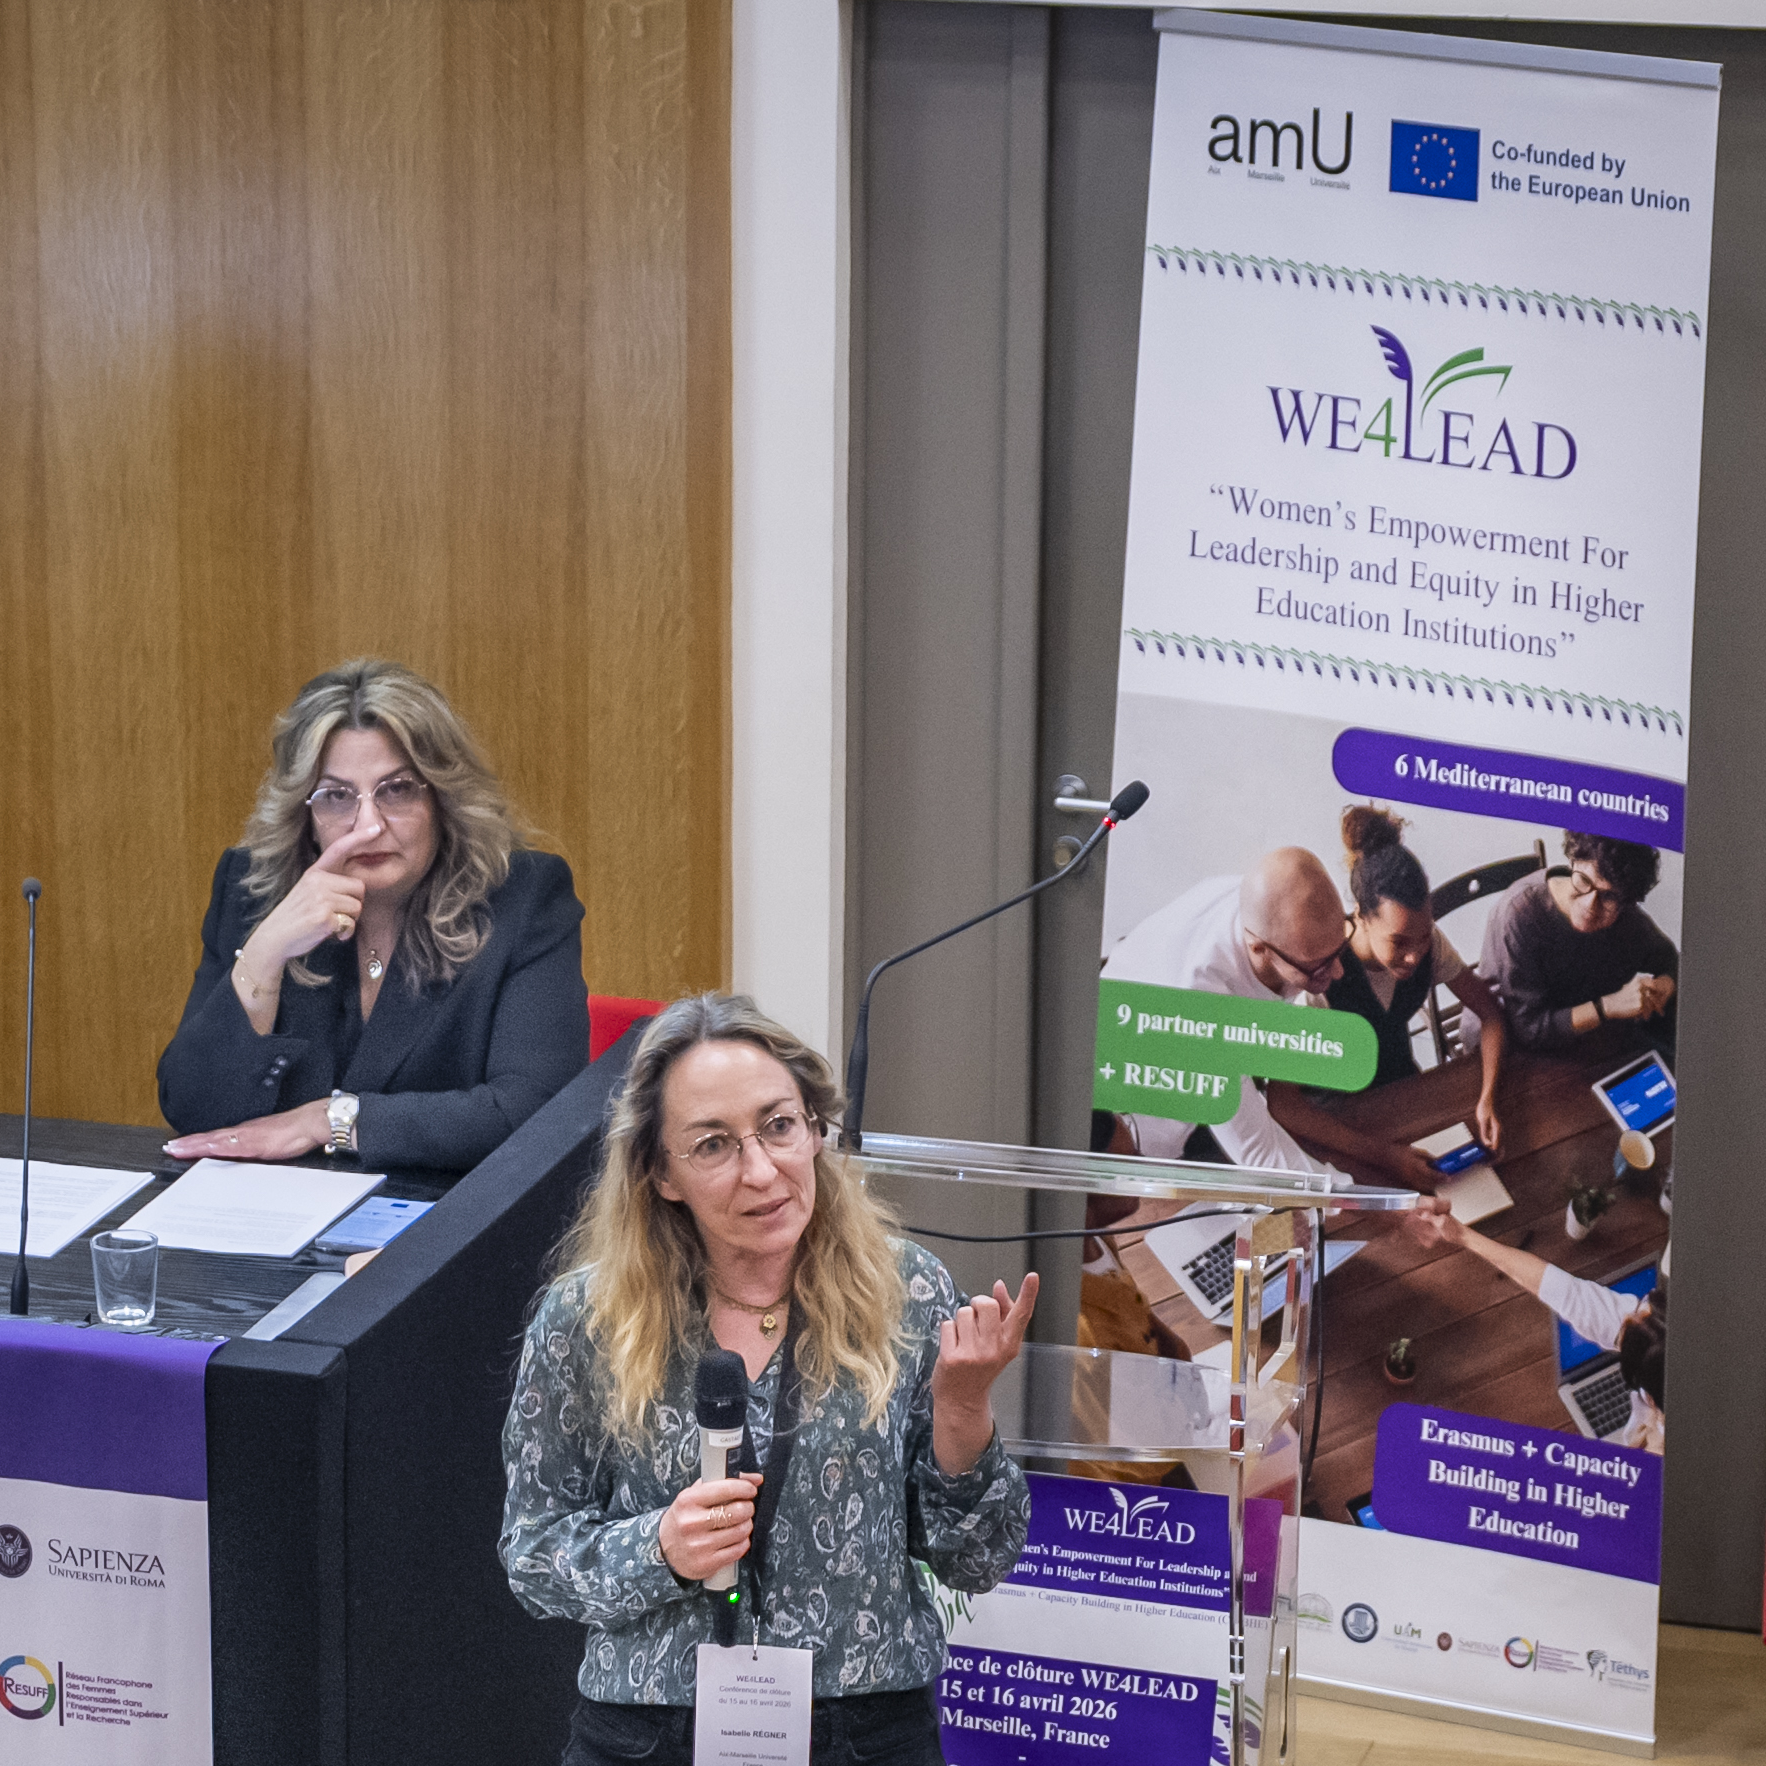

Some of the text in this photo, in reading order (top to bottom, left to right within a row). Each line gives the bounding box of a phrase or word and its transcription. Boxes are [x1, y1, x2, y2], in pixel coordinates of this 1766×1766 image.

[1207, 107, 1353, 176] amU
[1492, 140, 1626, 178] Co-funded by
[1491, 170, 1690, 212] the European Union
[1266, 372, 1577, 480] WE4LEAD
[1368, 506, 1570, 561] Empowerment
[1581, 535, 1629, 569] For
[1189, 530, 1644, 623] Leadership and Equity in Higher
[1255, 586, 1391, 633] Education
[1394, 753, 1669, 822] 6 Mediterranean countries
[1117, 1004, 1344, 1058] 9 partner universities
[1123, 1062, 1229, 1098] RESUFF
[1421, 1418, 1642, 1486] Erasmus + Capacity
[1428, 1460, 1630, 1520] Building in Higher
[1064, 1502, 1196, 1545] WE4LEAD
[1468, 1507, 1579, 1549] Education
[1043, 1564, 1053, 1575] in
[1057, 1566, 1096, 1583] Higher
[1100, 1571, 1156, 1590] Education
[1052, 1544, 1222, 1579] Empowerment For Leadership
[1038, 1591, 1078, 1607] Capacity
[1081, 1596, 1120, 1612] Building
[1123, 1600, 1132, 1611] in
[1135, 1603, 1167, 1619] Higher
[1170, 1607, 1215, 1623] Education
[737, 1675, 775, 1684] WE4LEAD
[979, 1655, 1001, 1675] de
[1007, 1657, 1074, 1685] clôture
[1081, 1668, 1199, 1702] WE4LEAD
[940, 1679, 1118, 1721] 15 et 16 avril 2026
[753, 1729, 787, 1740] RÉGNER
[941, 1706, 1110, 1748] Marseille, France
